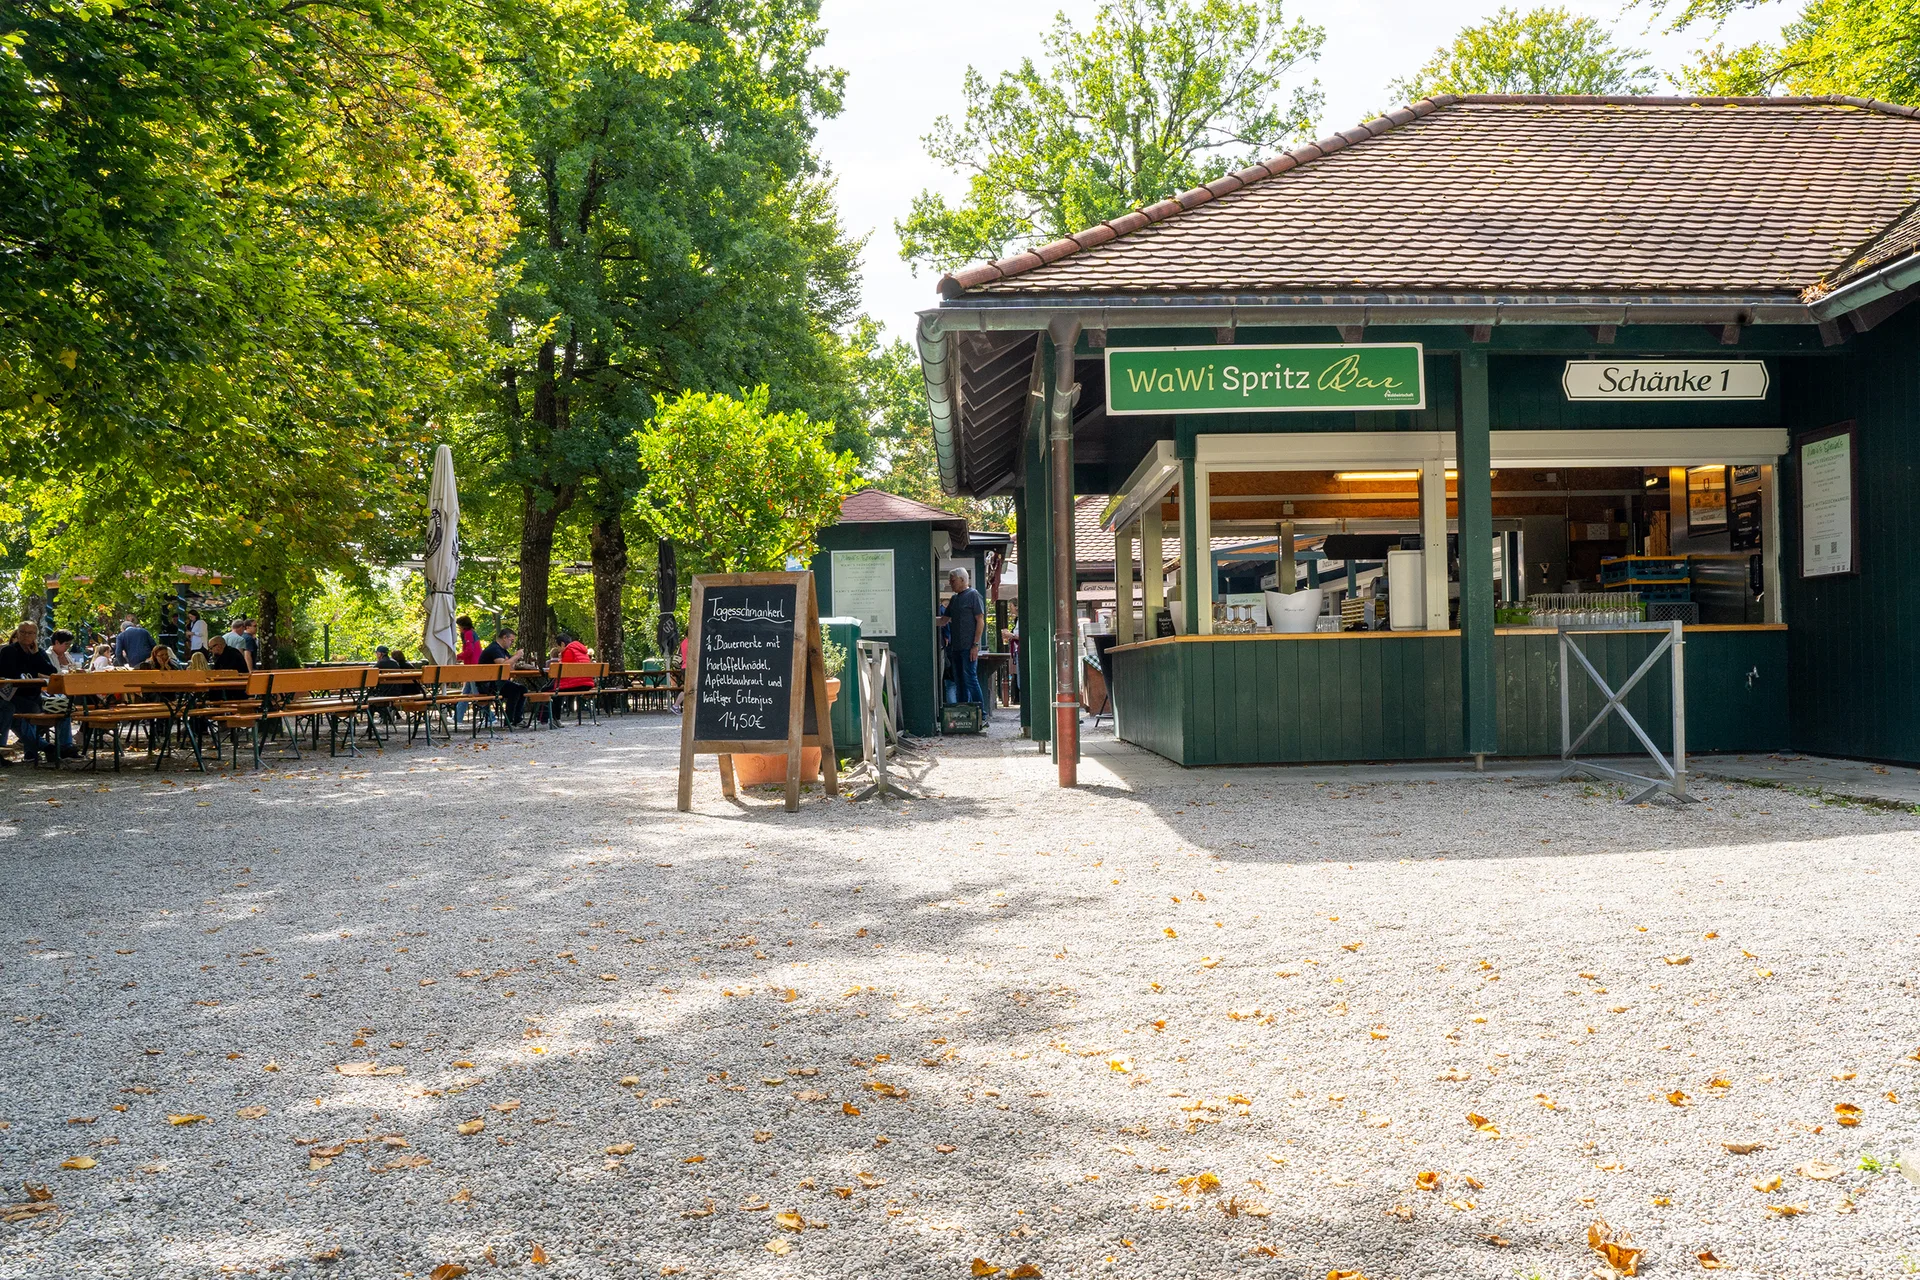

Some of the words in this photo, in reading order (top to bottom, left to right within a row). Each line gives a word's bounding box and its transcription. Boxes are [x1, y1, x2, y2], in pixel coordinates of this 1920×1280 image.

[1127, 364, 1214, 393] WaWi
[1222, 363, 1310, 397] Spritz
[1317, 354, 1403, 392] Bar
[1598, 367, 1712, 392] Schänke
[1720, 369, 1730, 392] 1
[708, 596, 785, 622] Tagesschmankerl
[713, 634, 762, 651] Bauernente
[766, 635, 781, 649] mit
[704, 673, 764, 689] Apfelblaukraut
[767, 675, 783, 688] und
[735, 689, 773, 711] Entenjus
[718, 711, 766, 731] 14,50€
